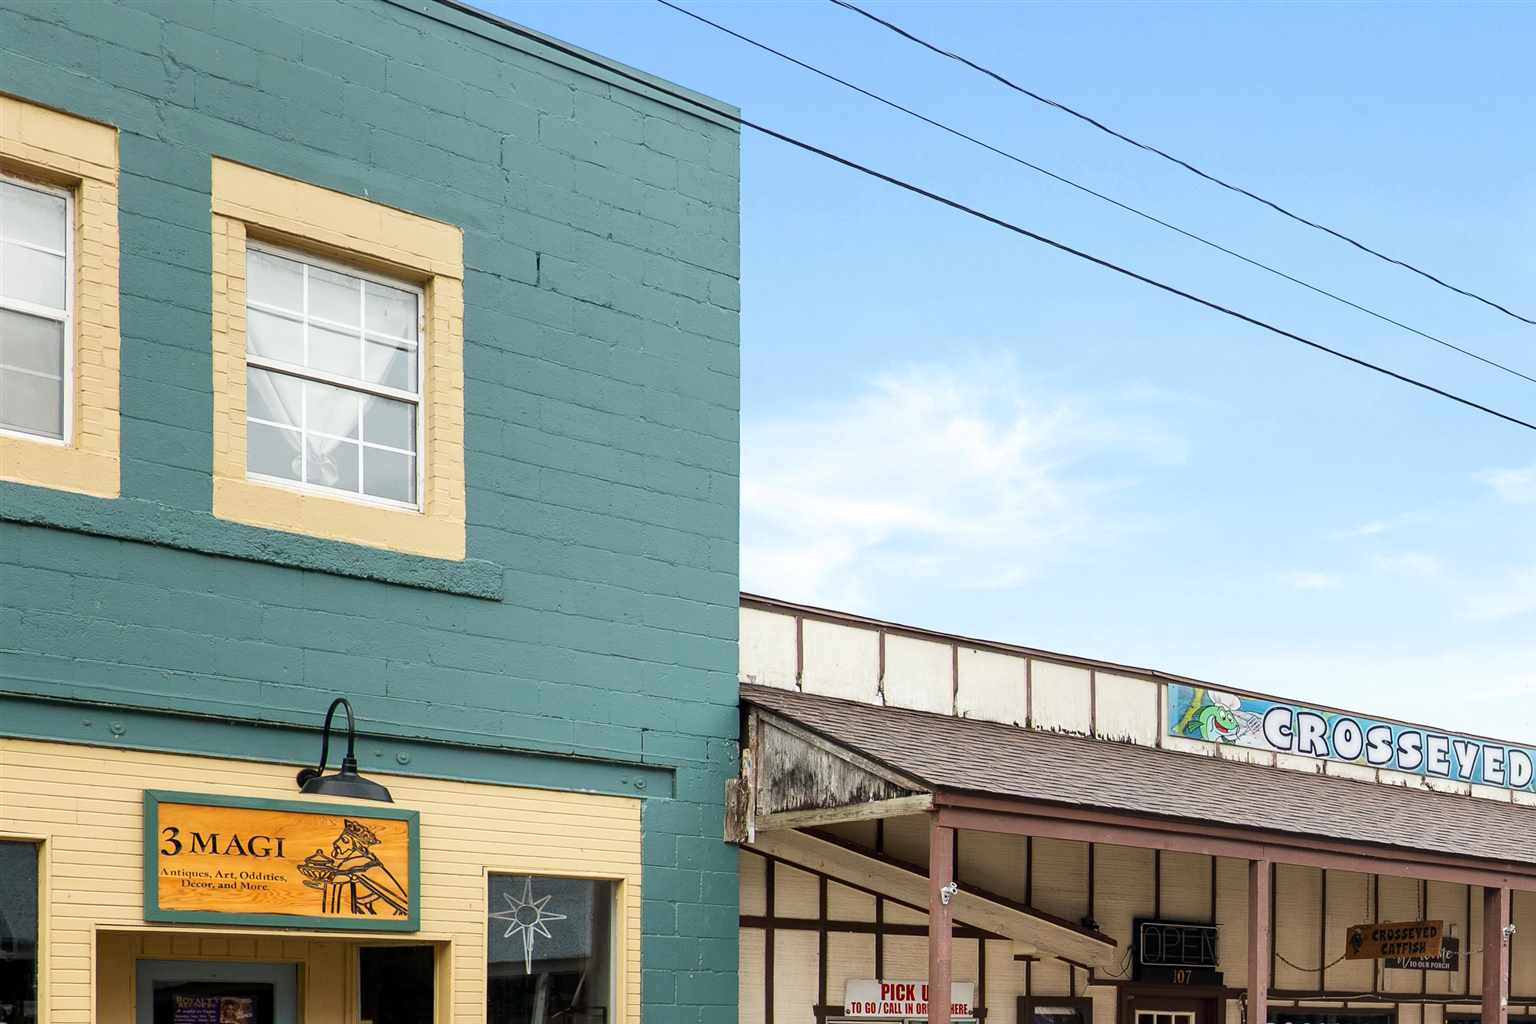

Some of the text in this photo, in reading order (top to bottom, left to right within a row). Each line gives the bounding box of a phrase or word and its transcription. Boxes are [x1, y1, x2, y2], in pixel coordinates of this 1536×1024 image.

[1262, 706, 1534, 788] CROSSEYED
[160, 826, 287, 858] 3 MAGI
[161, 868, 288, 882] Antiques, Art, Oddities,
[181, 879, 215, 890] Decor,
[217, 880, 237, 889] and
[1371, 926, 1438, 942] CROSSEYED
[1144, 926, 1217, 963] OPEN
[1381, 942, 1427, 955] CATFISH
[1430, 961, 1450, 969] PORCH
[1173, 969, 1193, 985] 107
[881, 983, 916, 1002] PICK
[851, 1001, 862, 1014] TO
[864, 1001, 876, 1015] GO
[883, 1001, 902, 1015] CALL
[904, 1002, 913, 1015] IN
